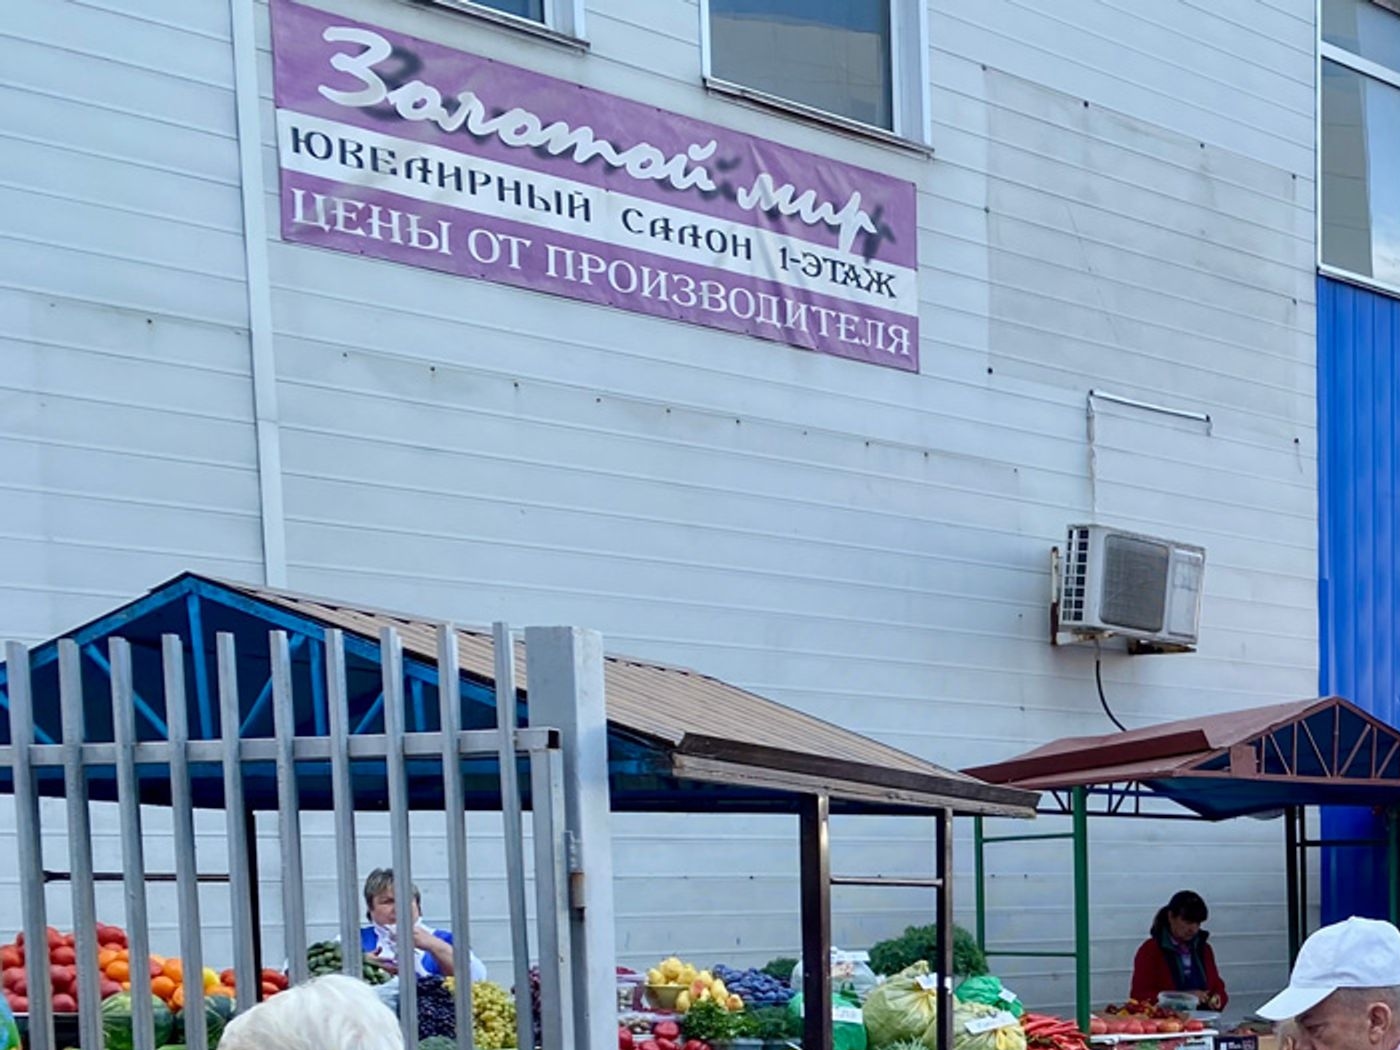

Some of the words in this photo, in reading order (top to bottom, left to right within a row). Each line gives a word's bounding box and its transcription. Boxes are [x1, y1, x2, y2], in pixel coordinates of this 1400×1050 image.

[290, 126, 592, 222] ЮВЕЛИРНЫЙ
[621, 207, 752, 261] САЛОН
[779, 247, 898, 299] 1-ЭТАЖ
[318, 26, 718, 190] Золотой
[737, 172, 878, 252] мир
[289, 188, 453, 258] ЦЕНЫ
[467, 229, 532, 270] ОТ
[545, 246, 912, 356] ПРОИЗВОДИТЕЛЯ
